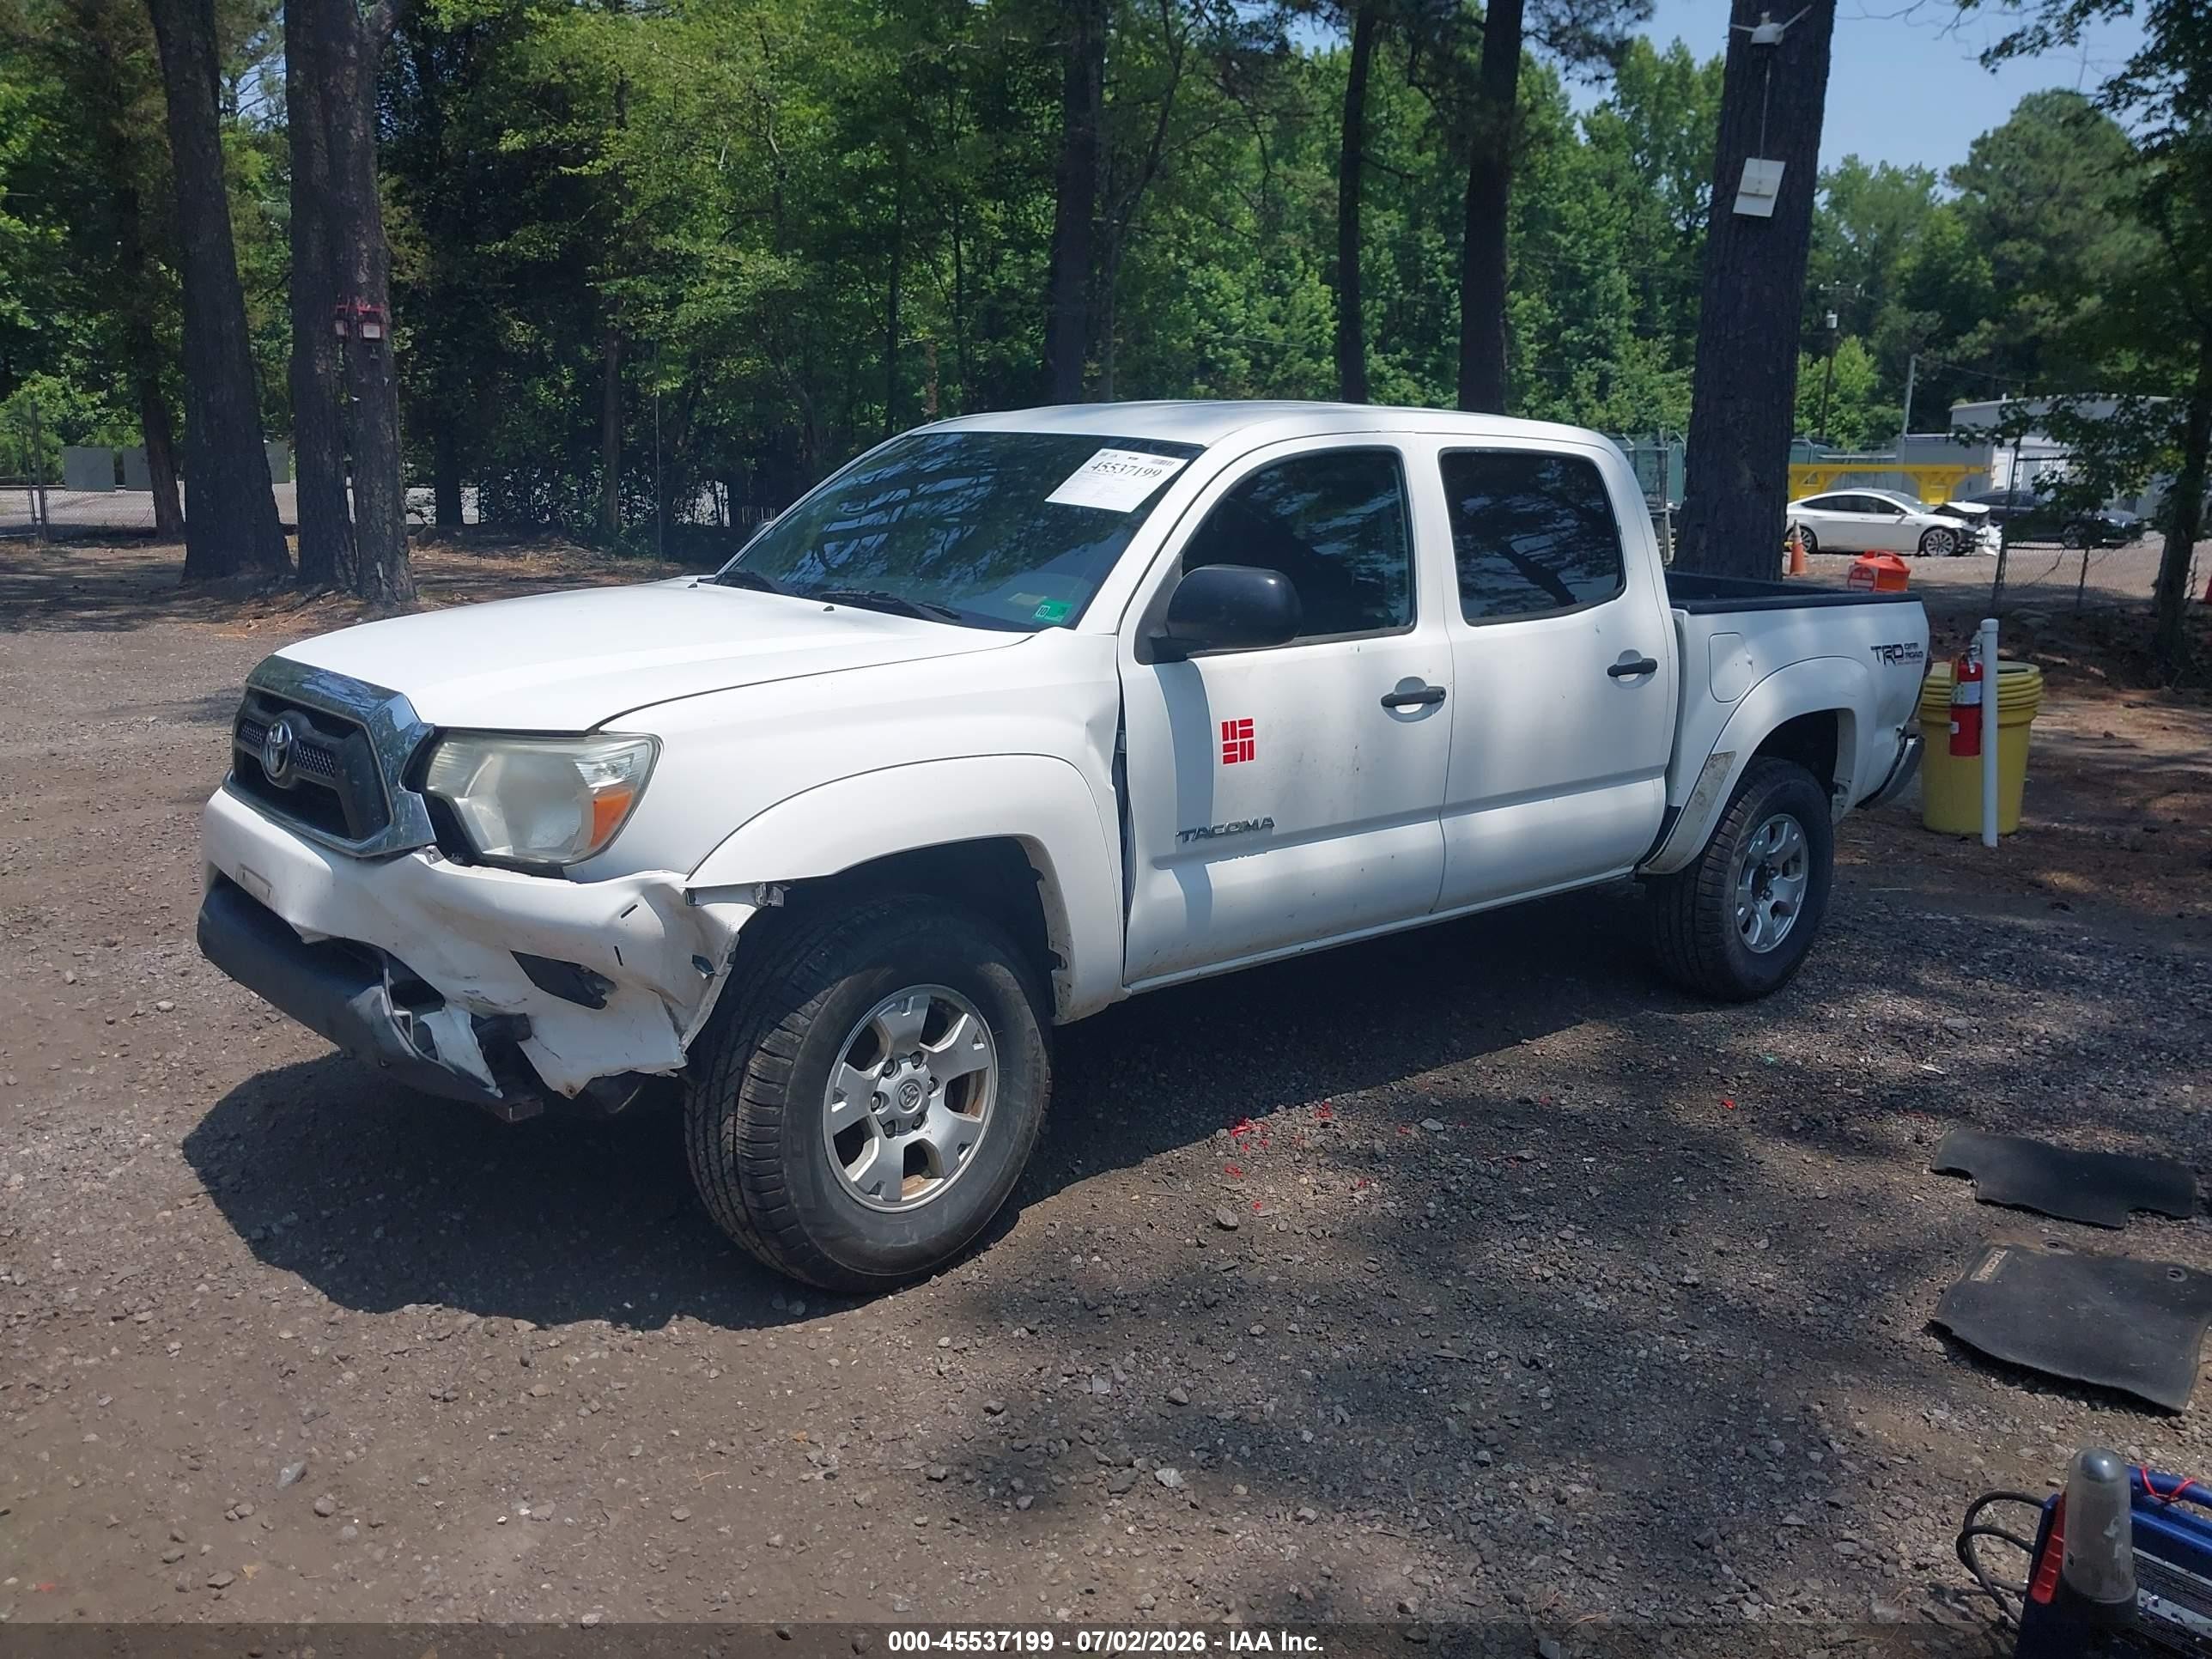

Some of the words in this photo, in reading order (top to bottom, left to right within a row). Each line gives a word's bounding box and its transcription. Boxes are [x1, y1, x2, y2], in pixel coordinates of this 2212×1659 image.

[1091, 461, 1163, 478] 45537199
[1870, 643, 1904, 666] TRD
[1176, 817, 1276, 843] TACOMA
